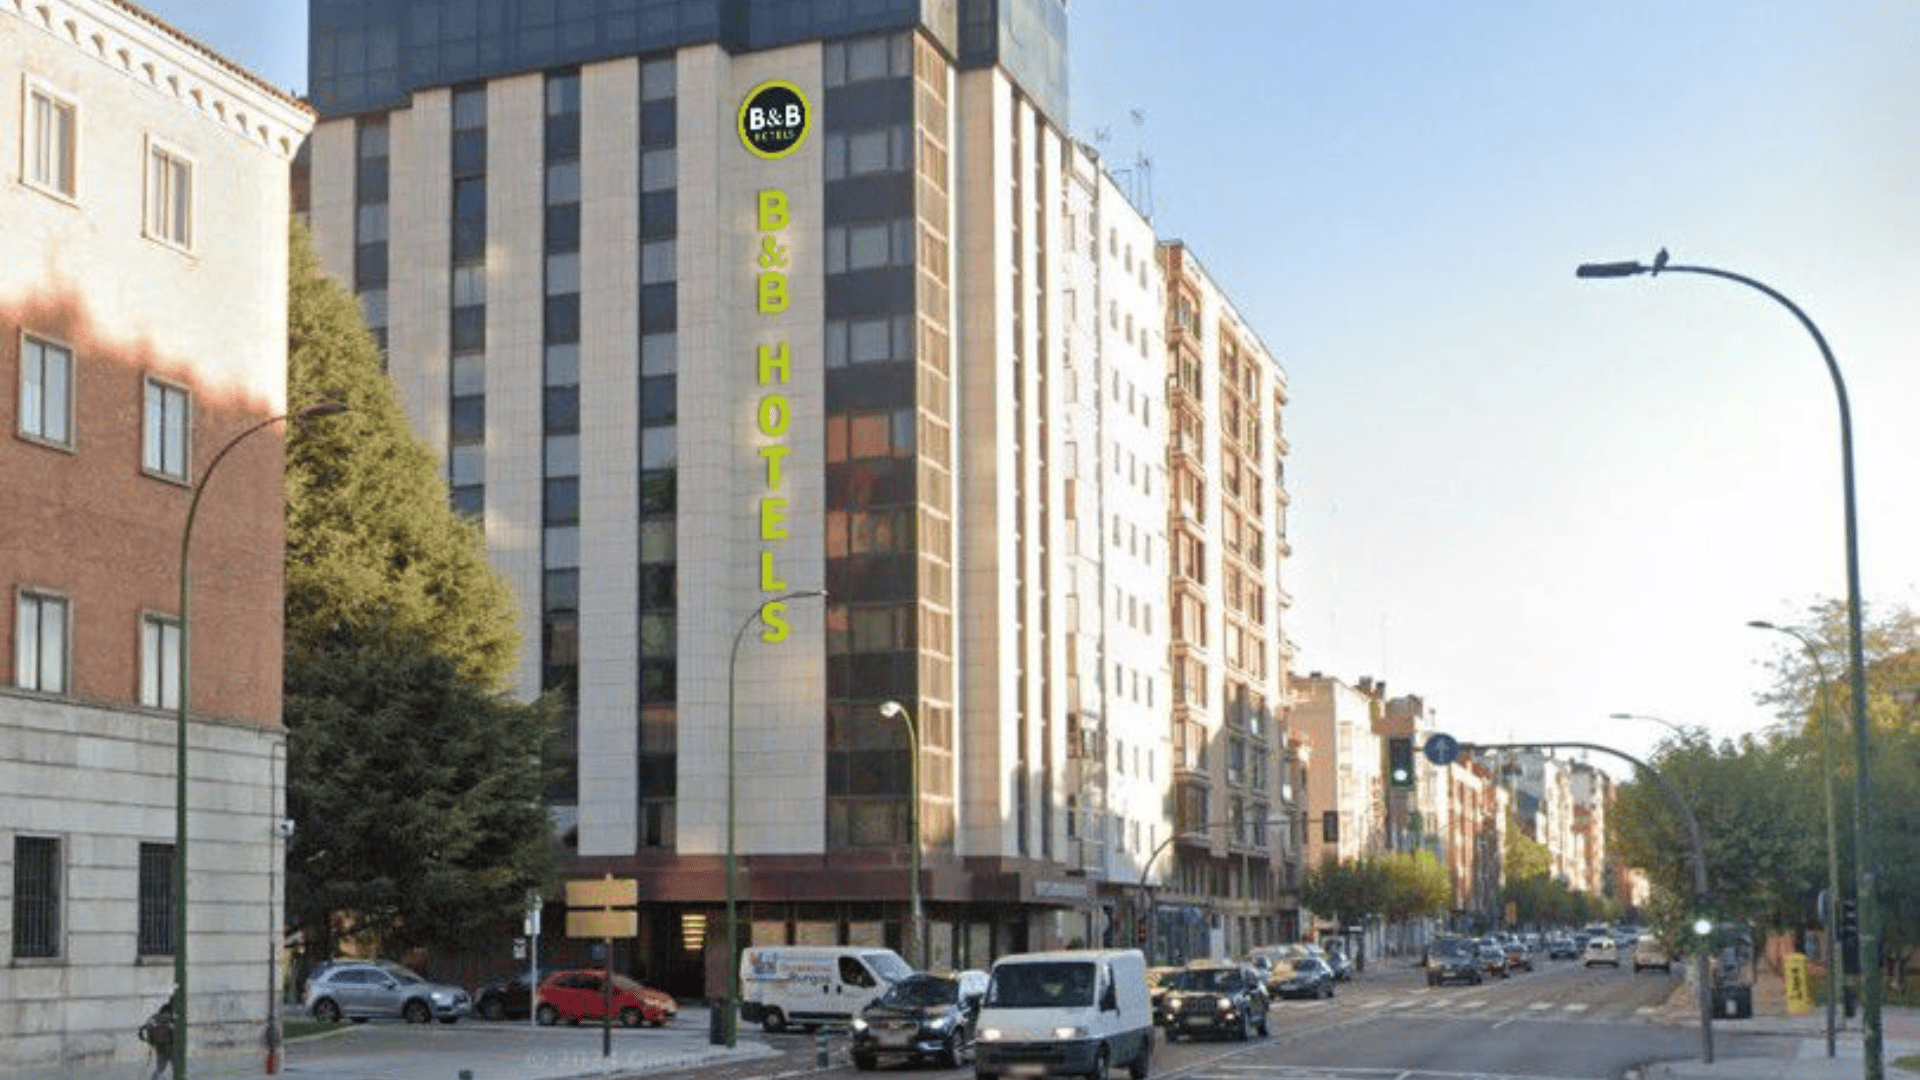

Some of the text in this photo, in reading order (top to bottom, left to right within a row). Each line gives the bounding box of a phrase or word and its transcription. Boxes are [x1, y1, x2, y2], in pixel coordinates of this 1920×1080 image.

[750, 104, 801, 131] B&B
[757, 189, 792, 644] B&B HOTELS
